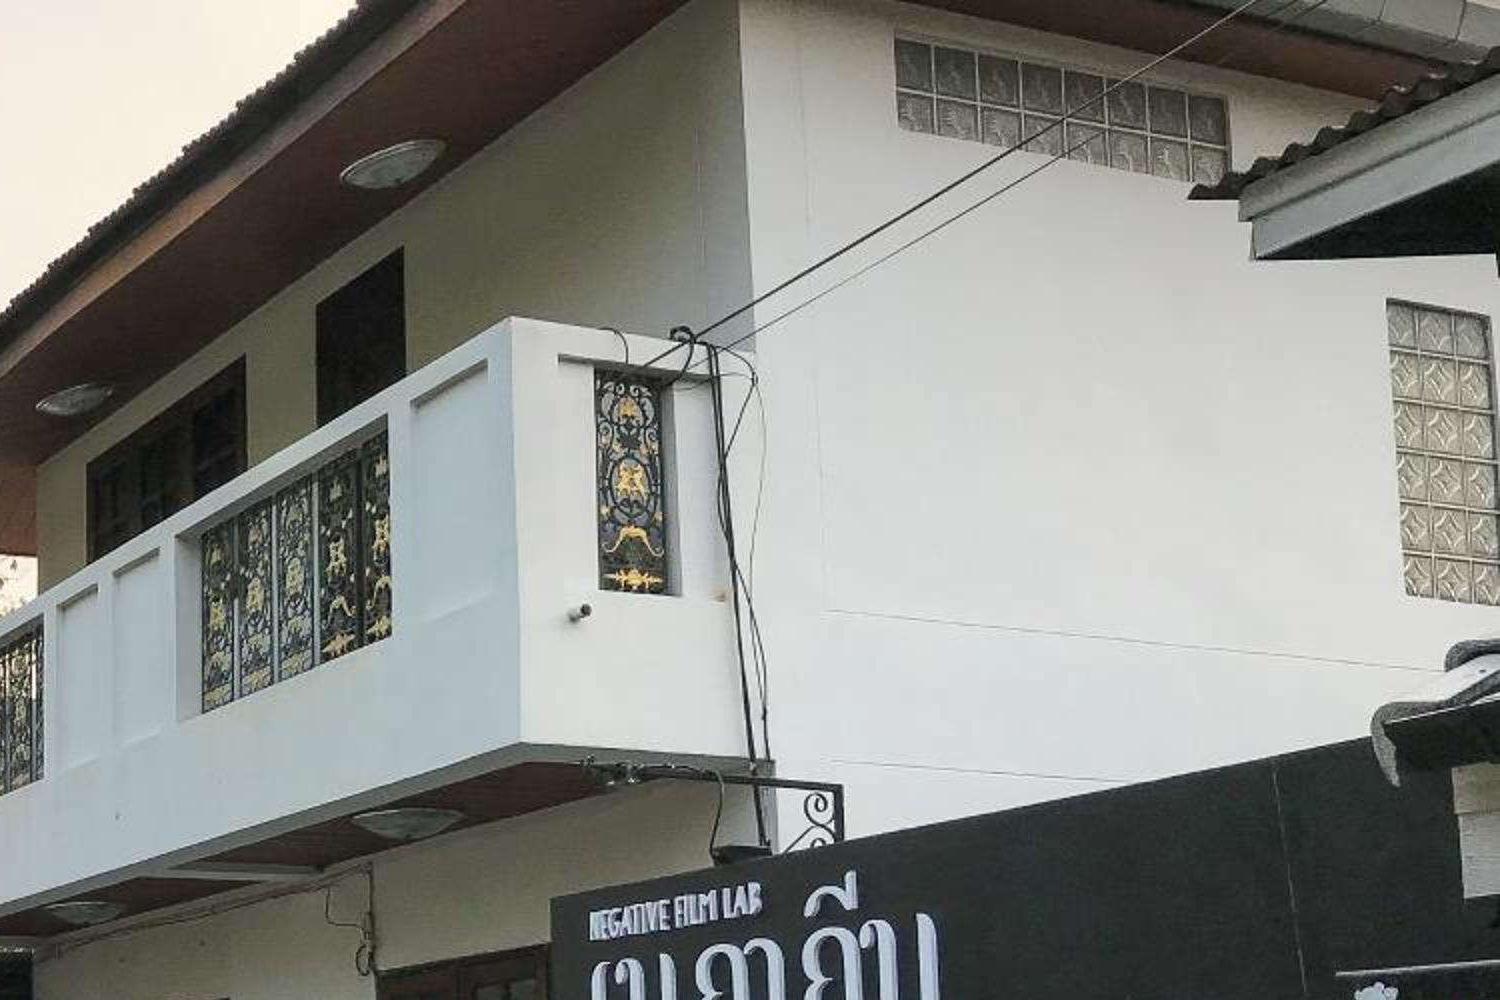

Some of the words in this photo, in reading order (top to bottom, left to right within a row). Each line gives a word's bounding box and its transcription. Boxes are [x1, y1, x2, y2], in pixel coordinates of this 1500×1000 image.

[589, 899, 671, 941] NEGATIVE
[673, 889, 719, 929] FILM
[722, 881, 763, 919] LAB
